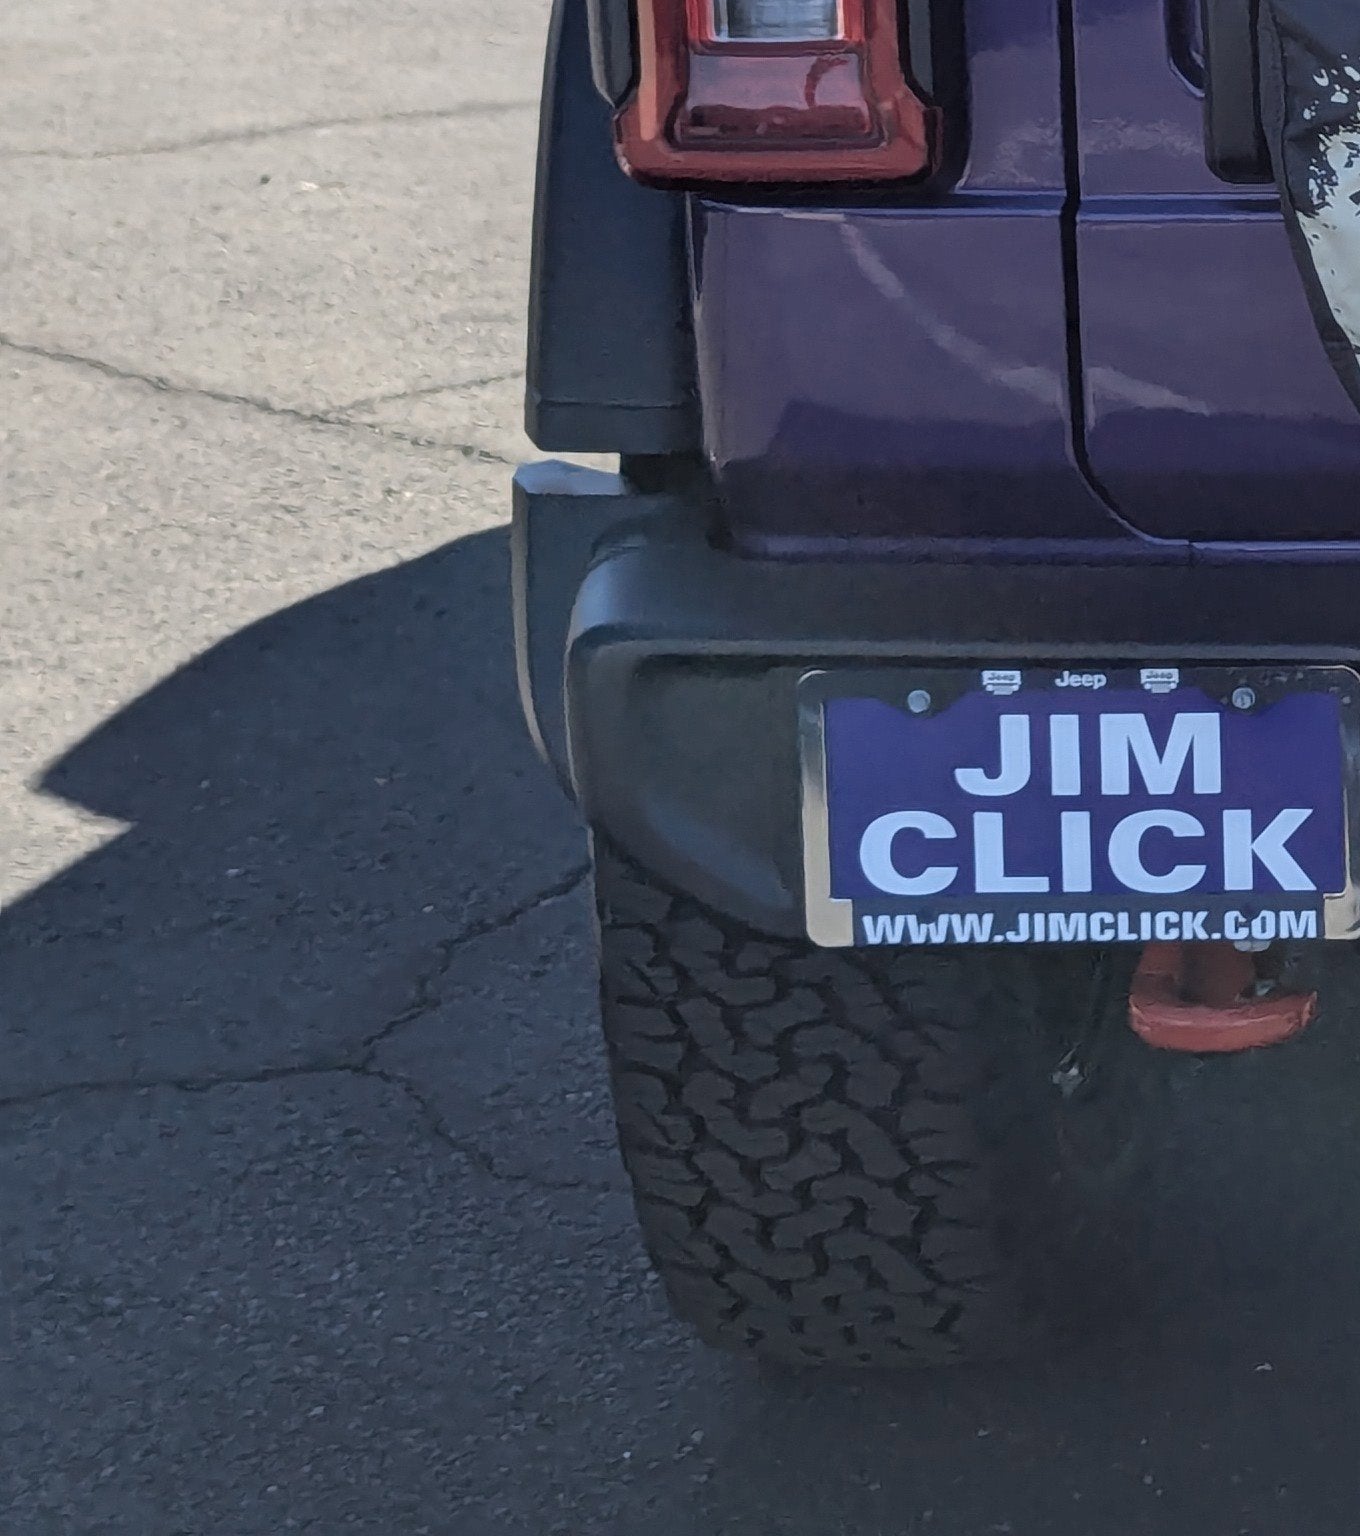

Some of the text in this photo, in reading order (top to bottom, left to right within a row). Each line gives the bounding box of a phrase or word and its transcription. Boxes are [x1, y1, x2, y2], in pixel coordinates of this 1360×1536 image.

[1054, 671, 1107, 689] Jeep
[954, 712, 1222, 796] JIM
[859, 808, 1317, 896] CLICK
[862, 910, 1317, 945] WWW.JIMCLICK.COM
